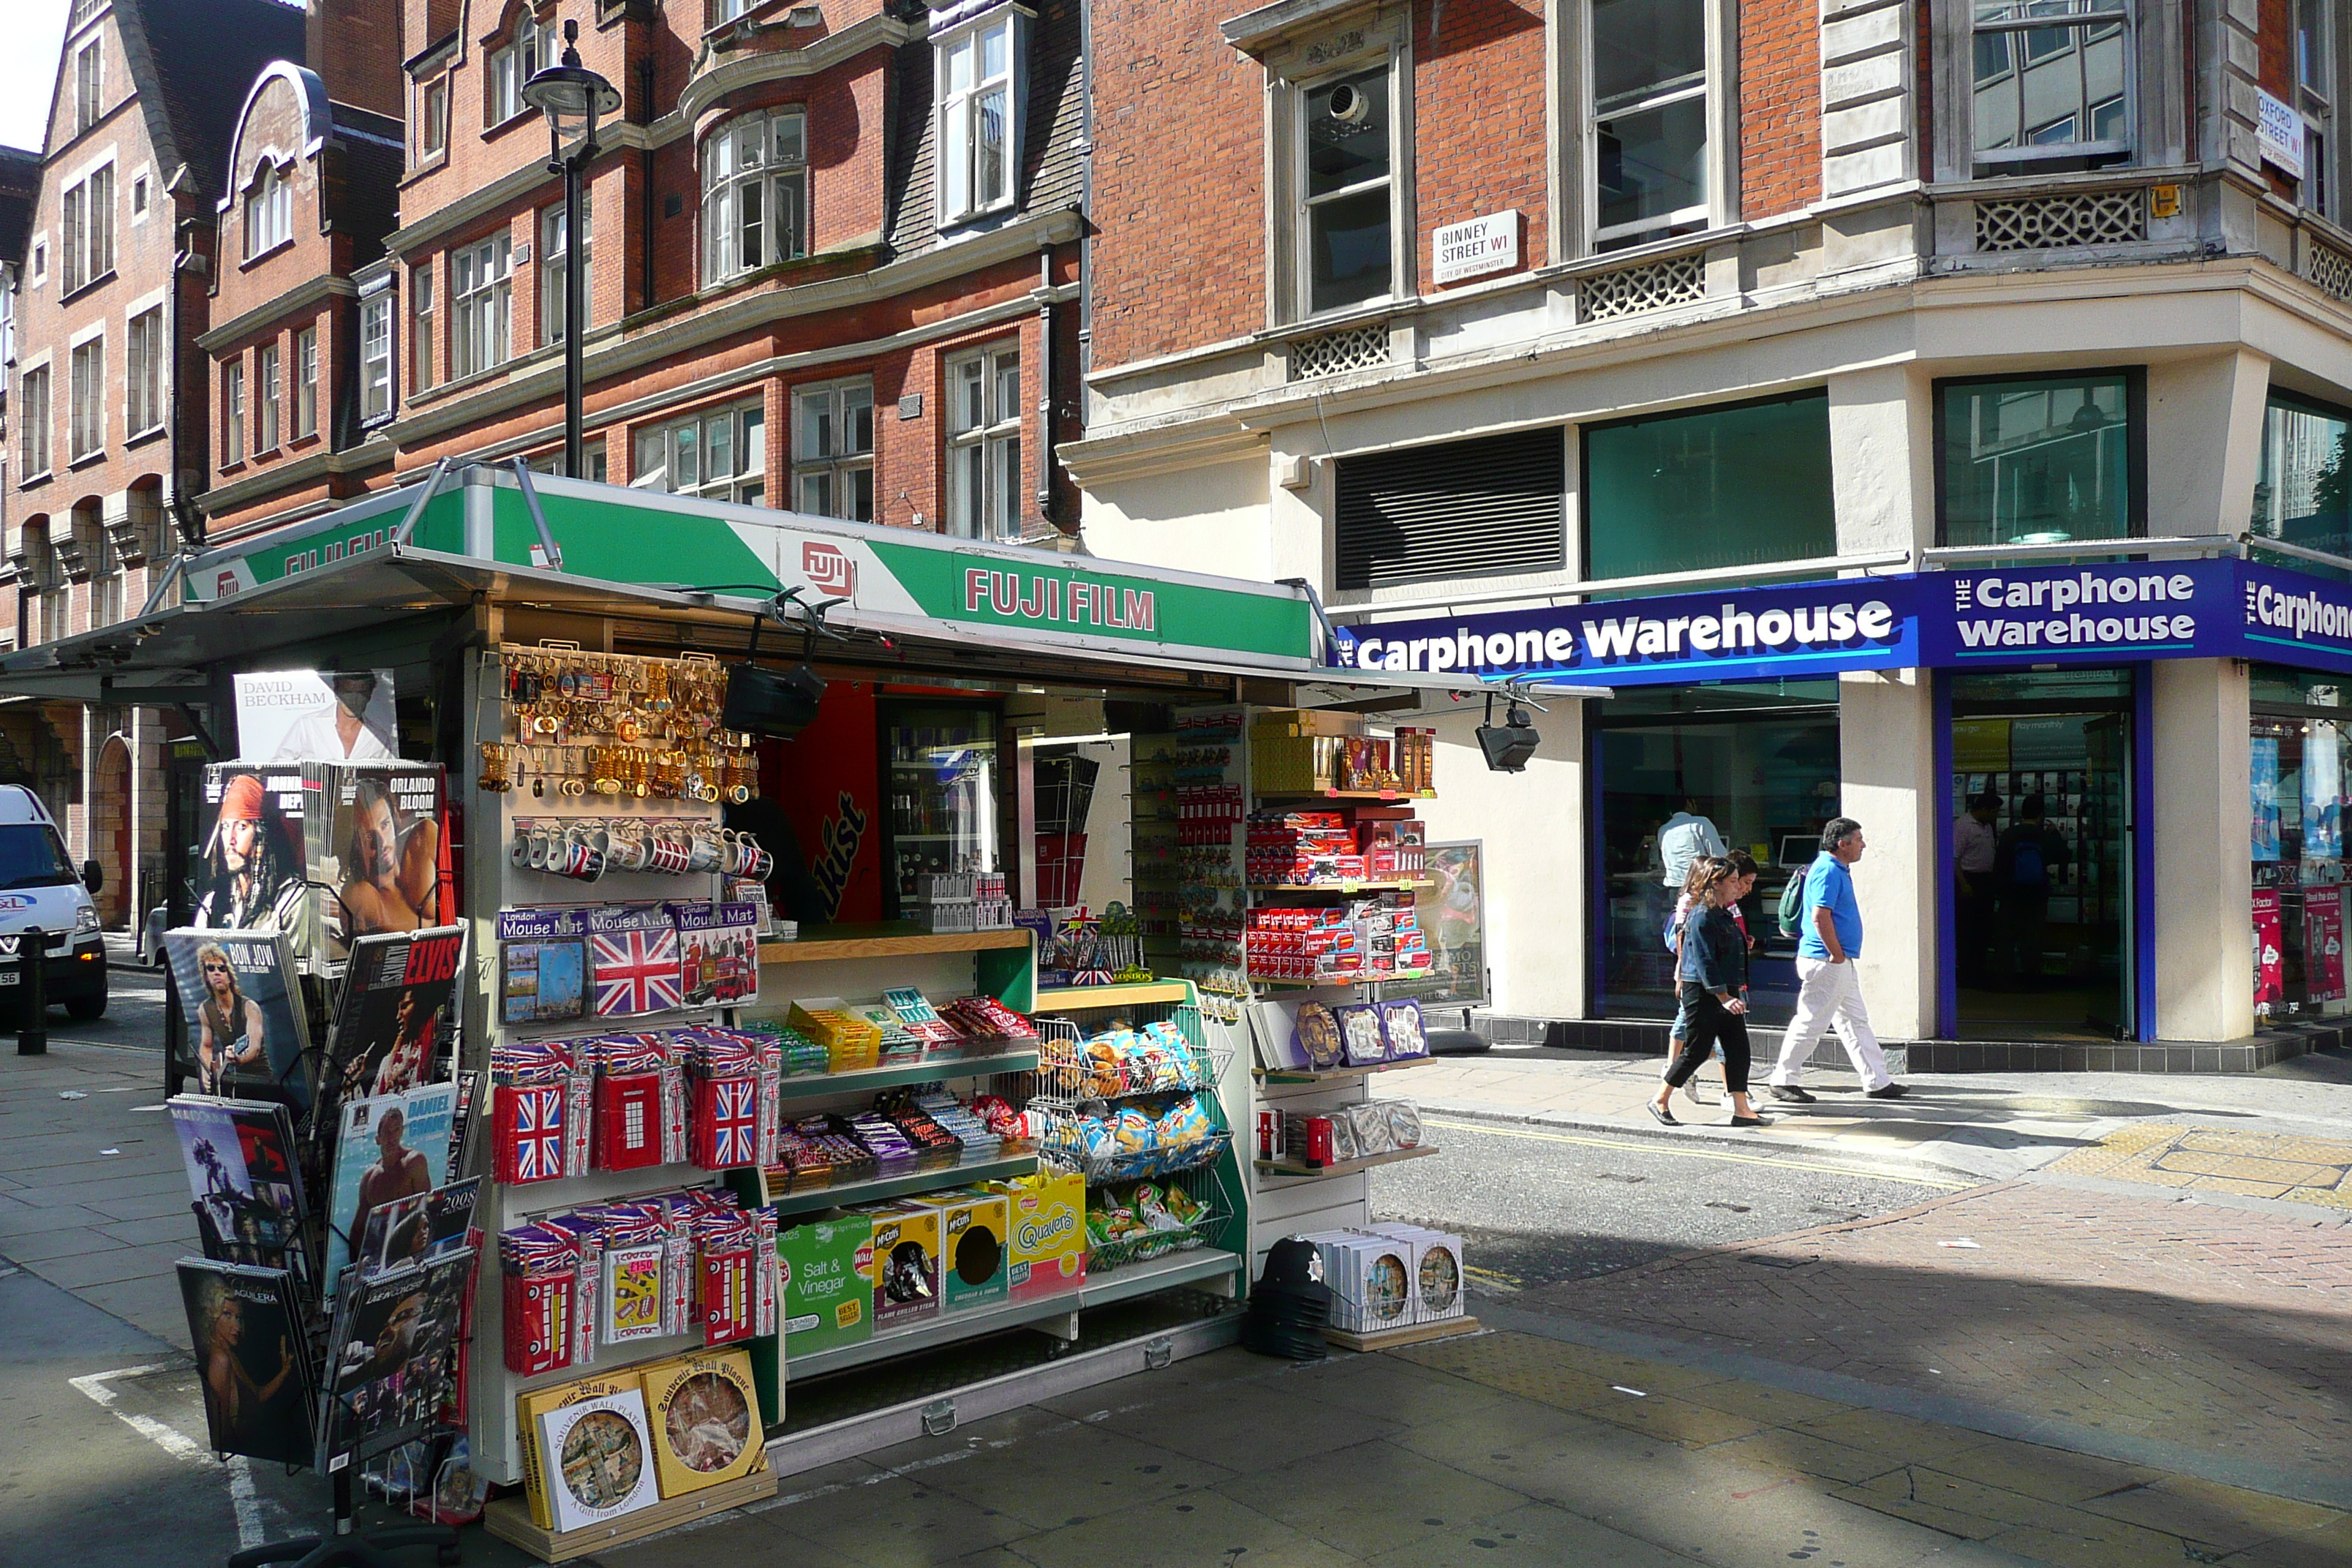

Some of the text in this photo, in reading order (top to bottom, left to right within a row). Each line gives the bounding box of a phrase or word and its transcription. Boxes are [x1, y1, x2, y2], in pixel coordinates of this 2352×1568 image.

[2258, 96, 2292, 129] OXFORD
[2258, 117, 2288, 145] STREET
[2274, 151, 2299, 173] WESTMINSTER
[1441, 222, 1488, 246] BINNEY
[1441, 234, 1507, 263] STREET W1
[1441, 258, 1504, 279] CITY OF WESTMINSTER
[1955, 571, 2195, 612] THE Carphone
[2244, 580, 2352, 642] THE Carphon
[1357, 627, 1573, 674] Carphone
[1582, 600, 1893, 659] Warehouse
[1956, 612, 2195, 647] Warehouse
[243, 680, 293, 694] DAVID
[244, 693, 326, 707] BECKHAM
[1968, 725, 1980, 733] go
[2015, 720, 2064, 730] Pay monthly
[2250, 725, 2264, 734] etter
[265, 775, 303, 792] JOHNN
[390, 777, 435, 794] ORLANDO
[279, 794, 304, 810] DEP
[400, 794, 434, 810] BLOOM
[812, 790, 867, 925] kist
[739, 892, 764, 902] LONDON
[2256, 898, 2272, 908] Factor
[2306, 892, 2339, 902] Steal the show
[505, 913, 536, 921] London
[592, 908, 622, 916] London
[680, 908, 754, 928] Mous Mat
[682, 905, 709, 915] London
[1013, 910, 1047, 920] LONDON
[503, 921, 550, 936] Mouse
[590, 916, 638, 931] Mouse
[229, 943, 276, 967] BON JOVI
[380, 944, 411, 982] ALWAYS
[403, 936, 460, 986] ELVIS
[1114, 973, 1152, 981] LONDON
[407, 1093, 450, 1119] DANIEL
[409, 1114, 447, 1137] CRAIG
[444, 1188, 476, 1208] 2008
[440, 1202, 473, 1216] CALENDAR
[851, 1221, 870, 1229] PACKS
[853, 1252, 873, 1264] WALK
[803, 1261, 828, 1278] Salt
[831, 1258, 840, 1273] &
[1011, 1264, 1028, 1276] BEST
[798, 1276, 846, 1296] Vinegar
[233, 1289, 278, 1303] AGUILERA
[838, 1303, 857, 1316] BEST
[878, 1301, 936, 1321] FLAME GRILLED STEAK
[557, 1390, 576, 1409] enir
[579, 1382, 605, 1395] Wall
[657, 1360, 750, 1413] Souvenir Wall Plaque
[554, 1400, 642, 1451] SOUVENIR WALL PLATE
[570, 1480, 646, 1518] A Gift from London
